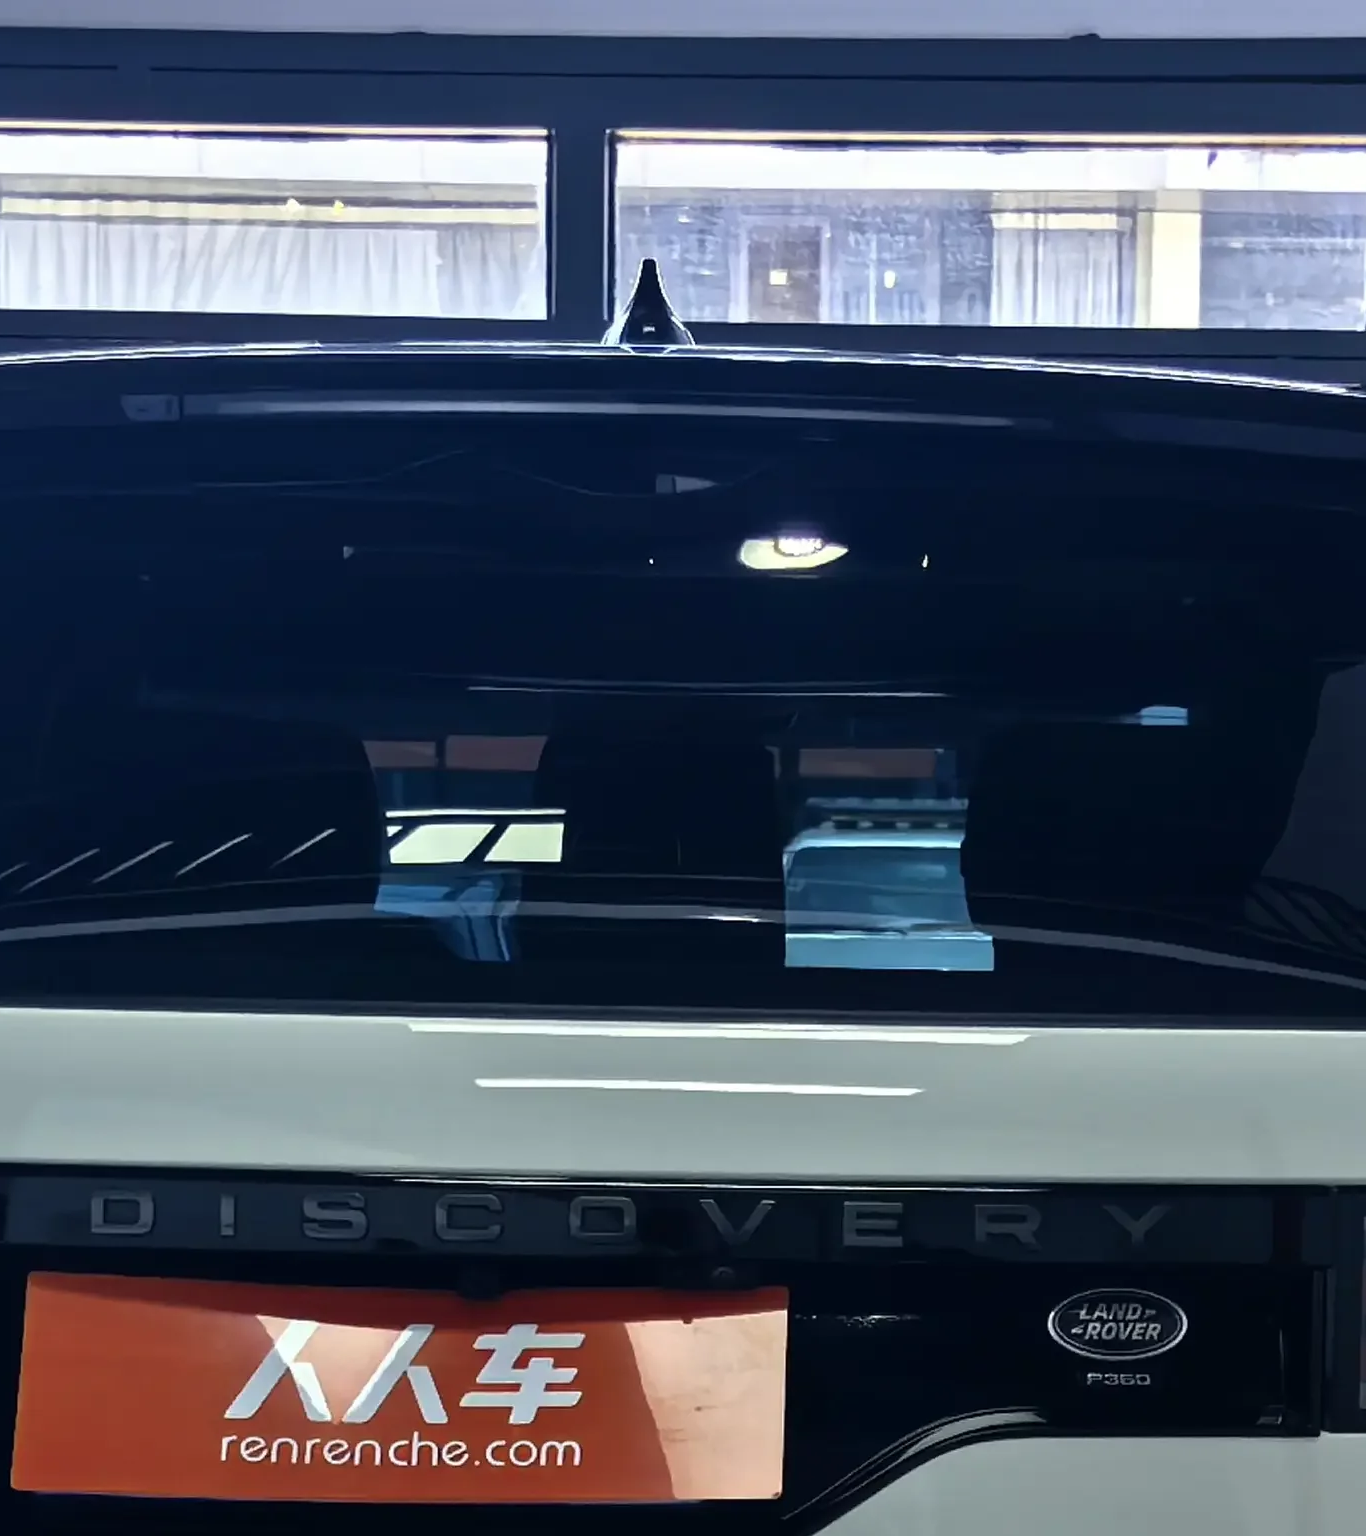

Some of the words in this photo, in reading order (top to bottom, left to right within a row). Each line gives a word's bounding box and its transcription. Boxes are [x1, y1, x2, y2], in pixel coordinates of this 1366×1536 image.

[90, 1191, 1173, 1249] DISCOVERY
[1079, 1303, 1142, 1320] LAND
[1085, 1322, 1162, 1340] ROVER
[223, 1320, 585, 1425] 人人车
[220, 1431, 581, 1466] renrenche.com
